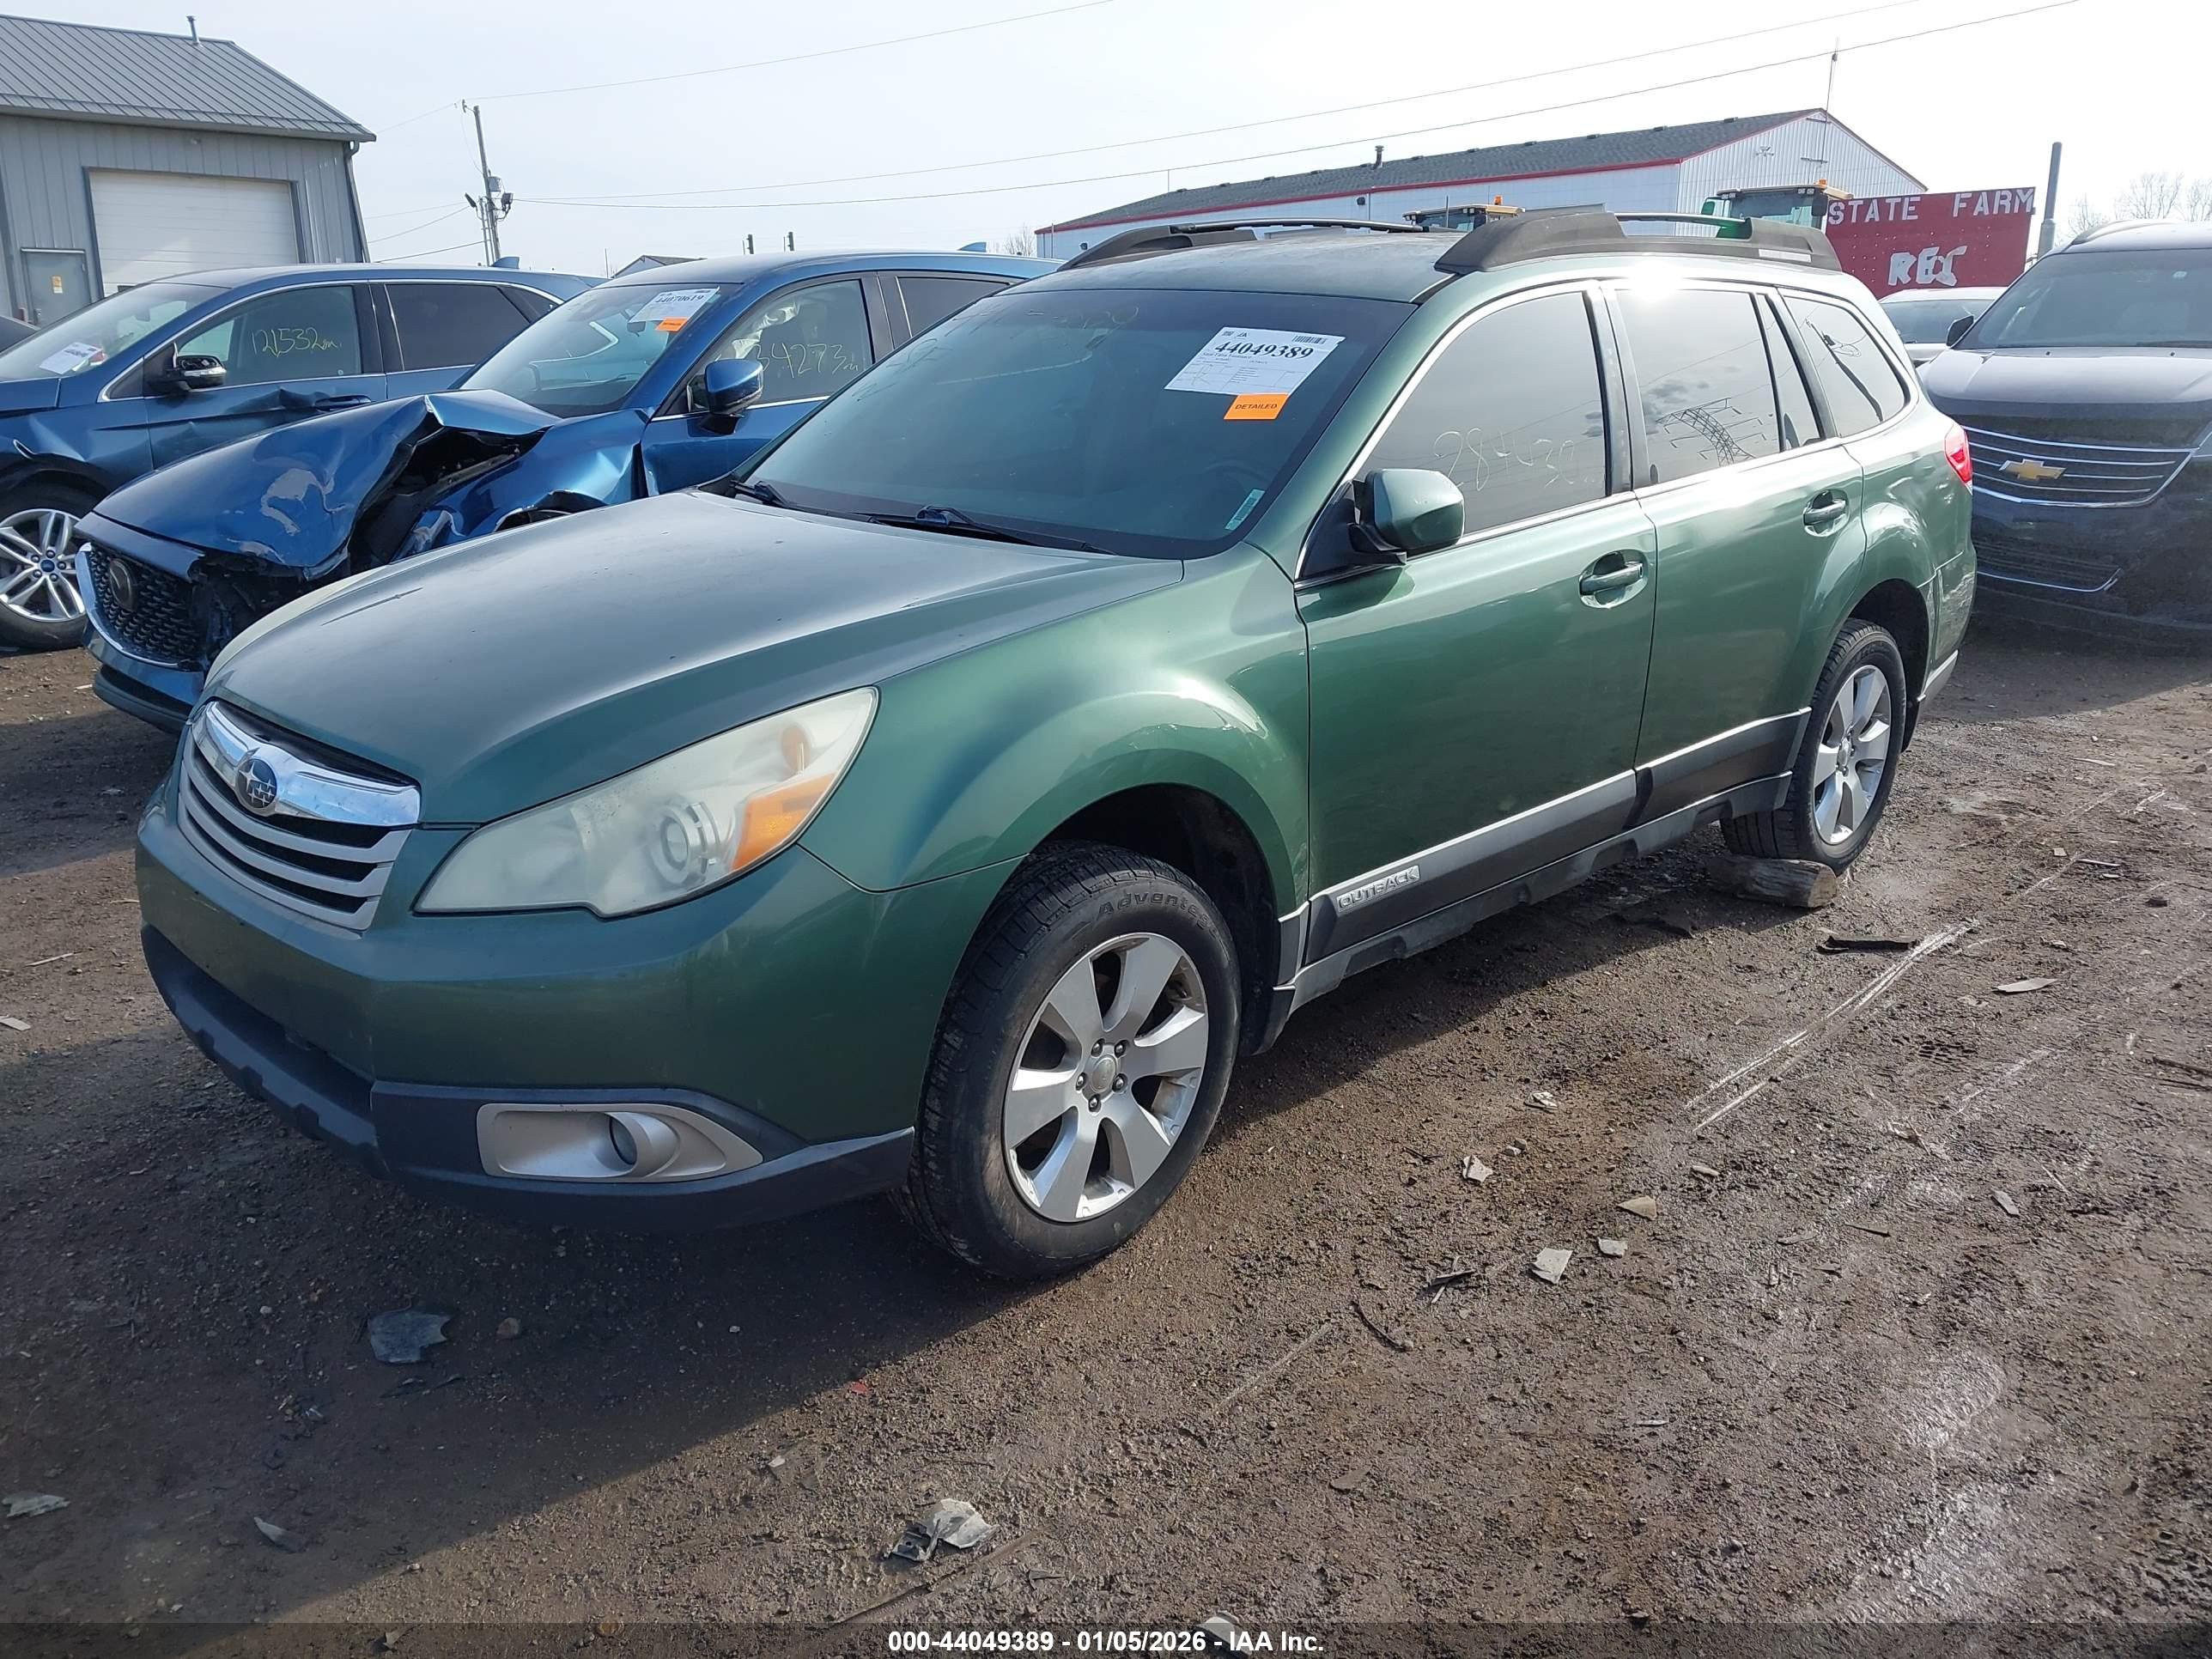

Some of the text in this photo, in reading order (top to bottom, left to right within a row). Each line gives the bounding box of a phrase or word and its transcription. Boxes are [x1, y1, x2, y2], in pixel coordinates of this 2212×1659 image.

[1827, 188, 2034, 225] STATE FARM
[1214, 341, 1314, 359] 44049389
[1340, 867, 1417, 908] OUTBACK
